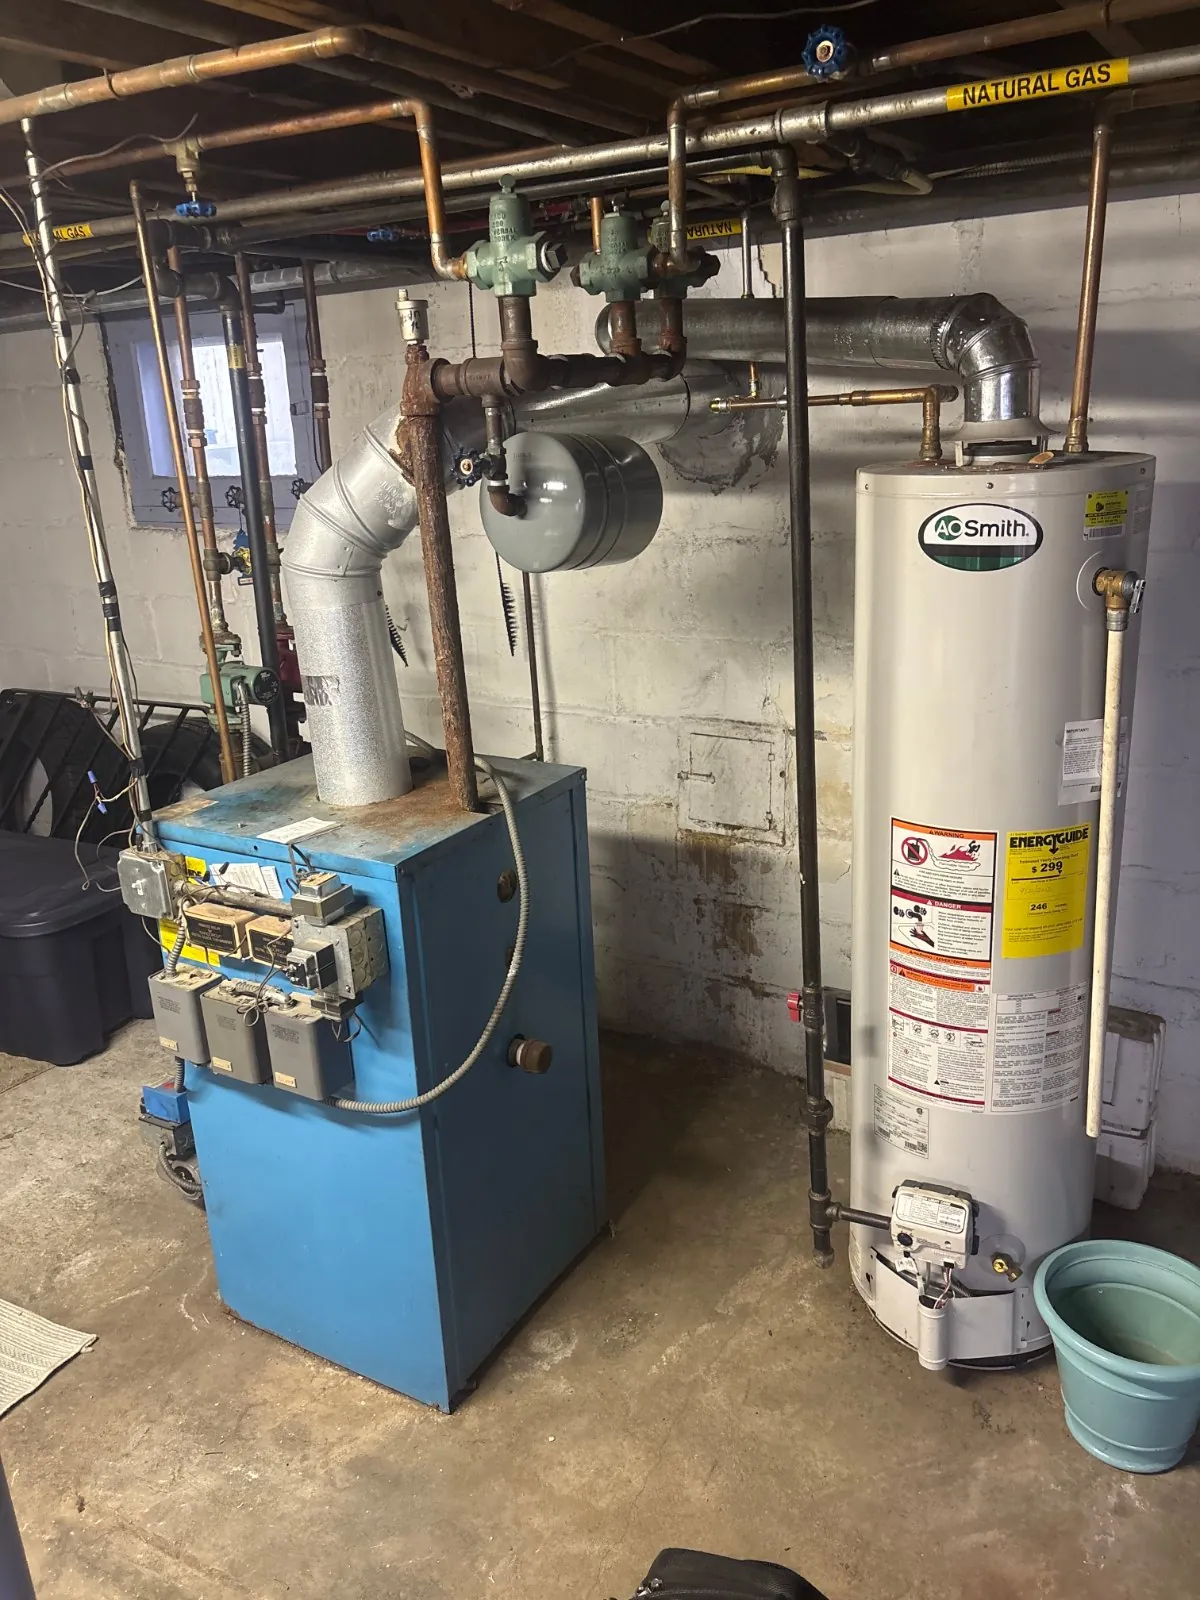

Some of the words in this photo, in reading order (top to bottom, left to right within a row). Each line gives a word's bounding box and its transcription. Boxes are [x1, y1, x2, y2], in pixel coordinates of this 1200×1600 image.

[963, 74, 1059, 106] NATURAL
[1065, 63, 1112, 89] GAS
[67, 225, 86, 239] GAS
[686, 221, 733, 238] NATURA
[933, 830, 965, 839] WARNING
[1009, 827, 1089, 849] ENERGYGUIDE
[1040, 861, 1063, 873] 299
[934, 901, 962, 909] DANGER
[1030, 903, 1048, 911] 246
